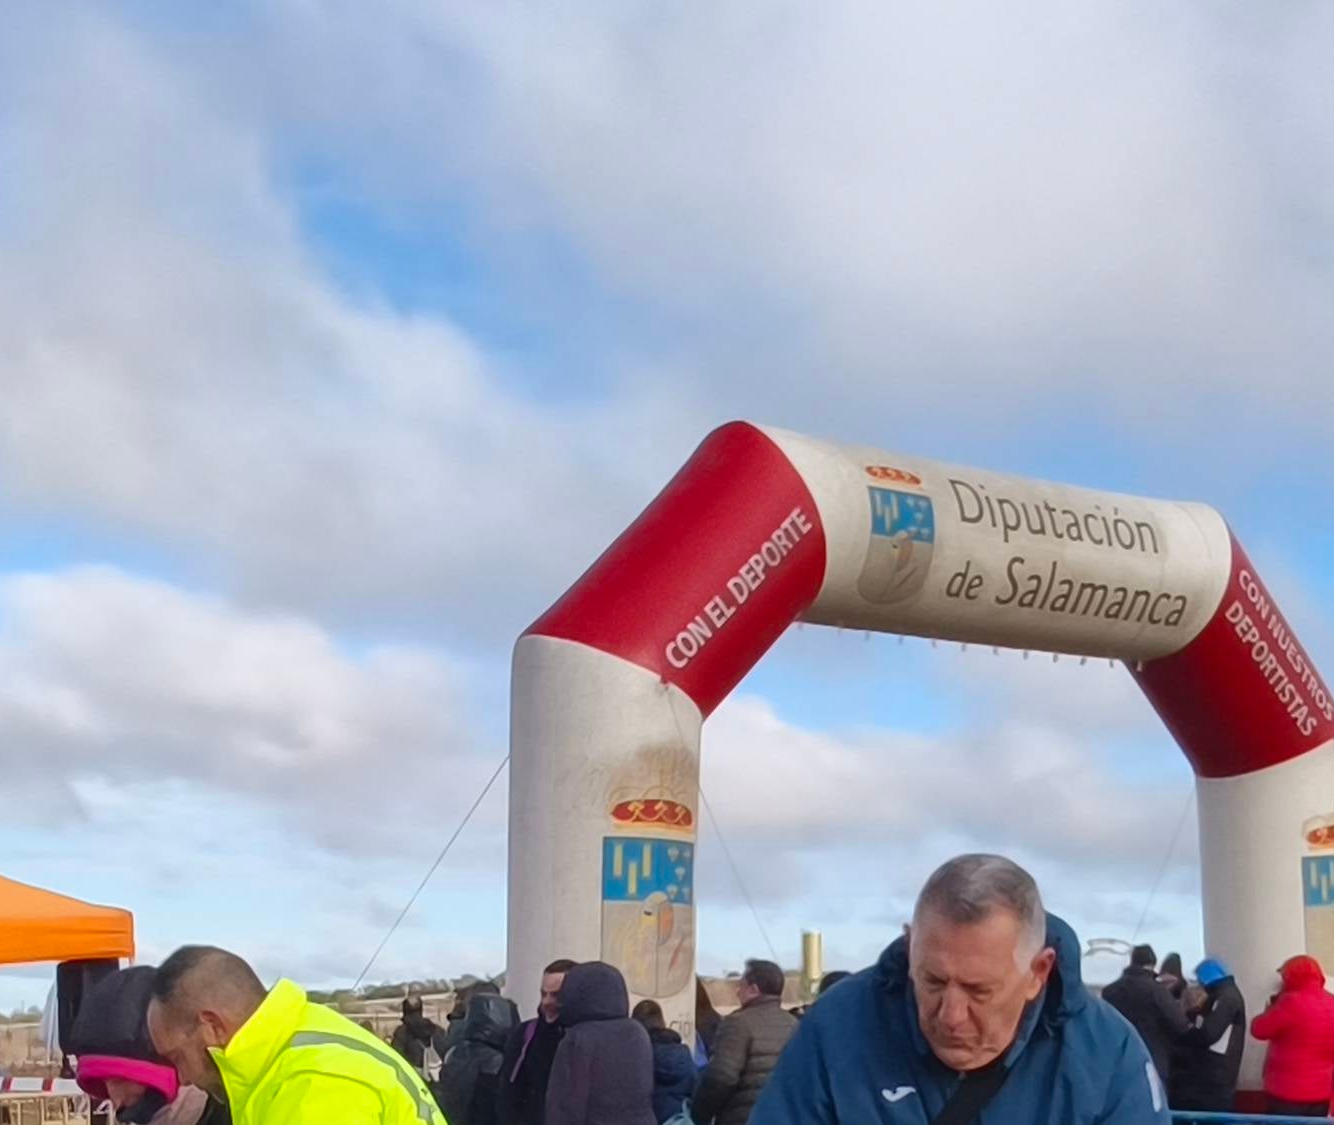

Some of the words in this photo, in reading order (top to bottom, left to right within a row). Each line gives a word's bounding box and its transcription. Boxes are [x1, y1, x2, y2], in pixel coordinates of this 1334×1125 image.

[948, 479, 1159, 554] Diputación
[666, 616, 713, 668] CON
[704, 595, 736, 628] EL
[726, 507, 813, 604] DEPORTE
[945, 560, 983, 600] de
[995, 556, 1187, 626] Salamanca
[1239, 569, 1270, 620] CON
[1267, 614, 1334, 721] NUESTROS
[1224, 600, 1317, 736] DEPORTISTAS
